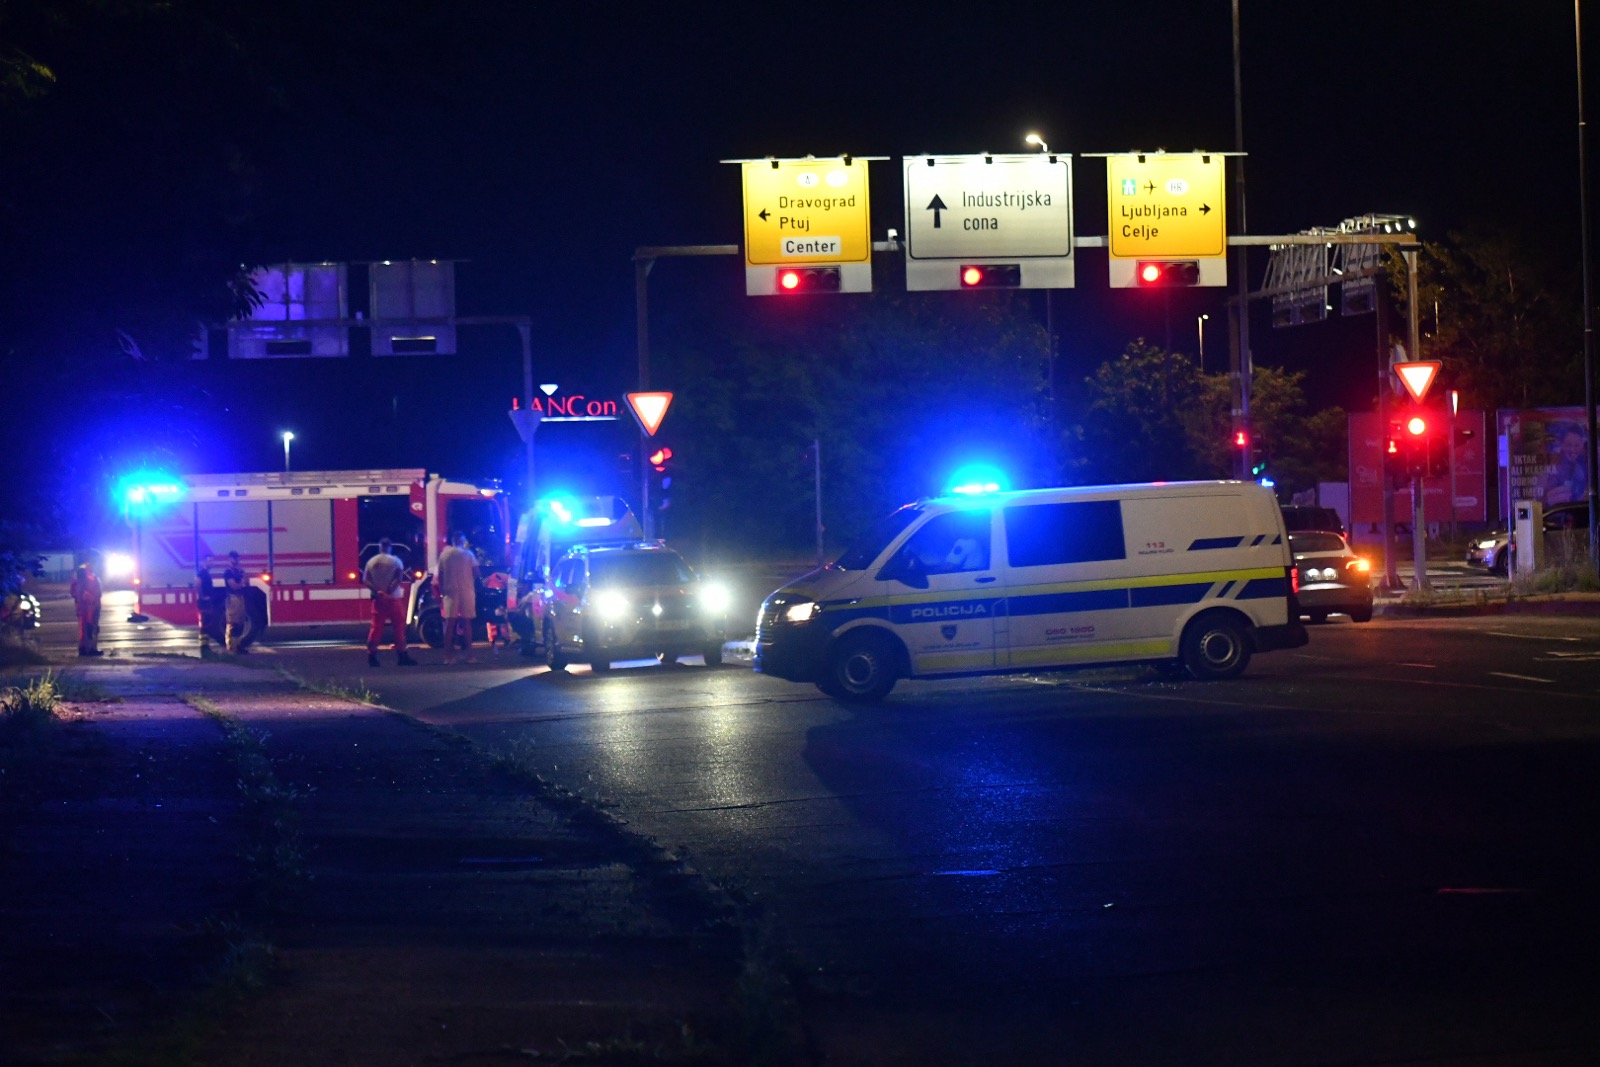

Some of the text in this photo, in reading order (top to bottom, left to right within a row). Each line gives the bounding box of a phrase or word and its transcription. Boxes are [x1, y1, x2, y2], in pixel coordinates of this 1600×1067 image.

[779, 195, 855, 211] Dravograd
[963, 190, 1051, 211] Industrijska
[1122, 204, 1187, 220] Ljubljana
[779, 216, 810, 232] Ptuj
[963, 217, 998, 231] cona
[1122, 224, 1159, 241] Celje
[786, 240, 836, 253] Center
[911, 604, 987, 618] POLICIJA
